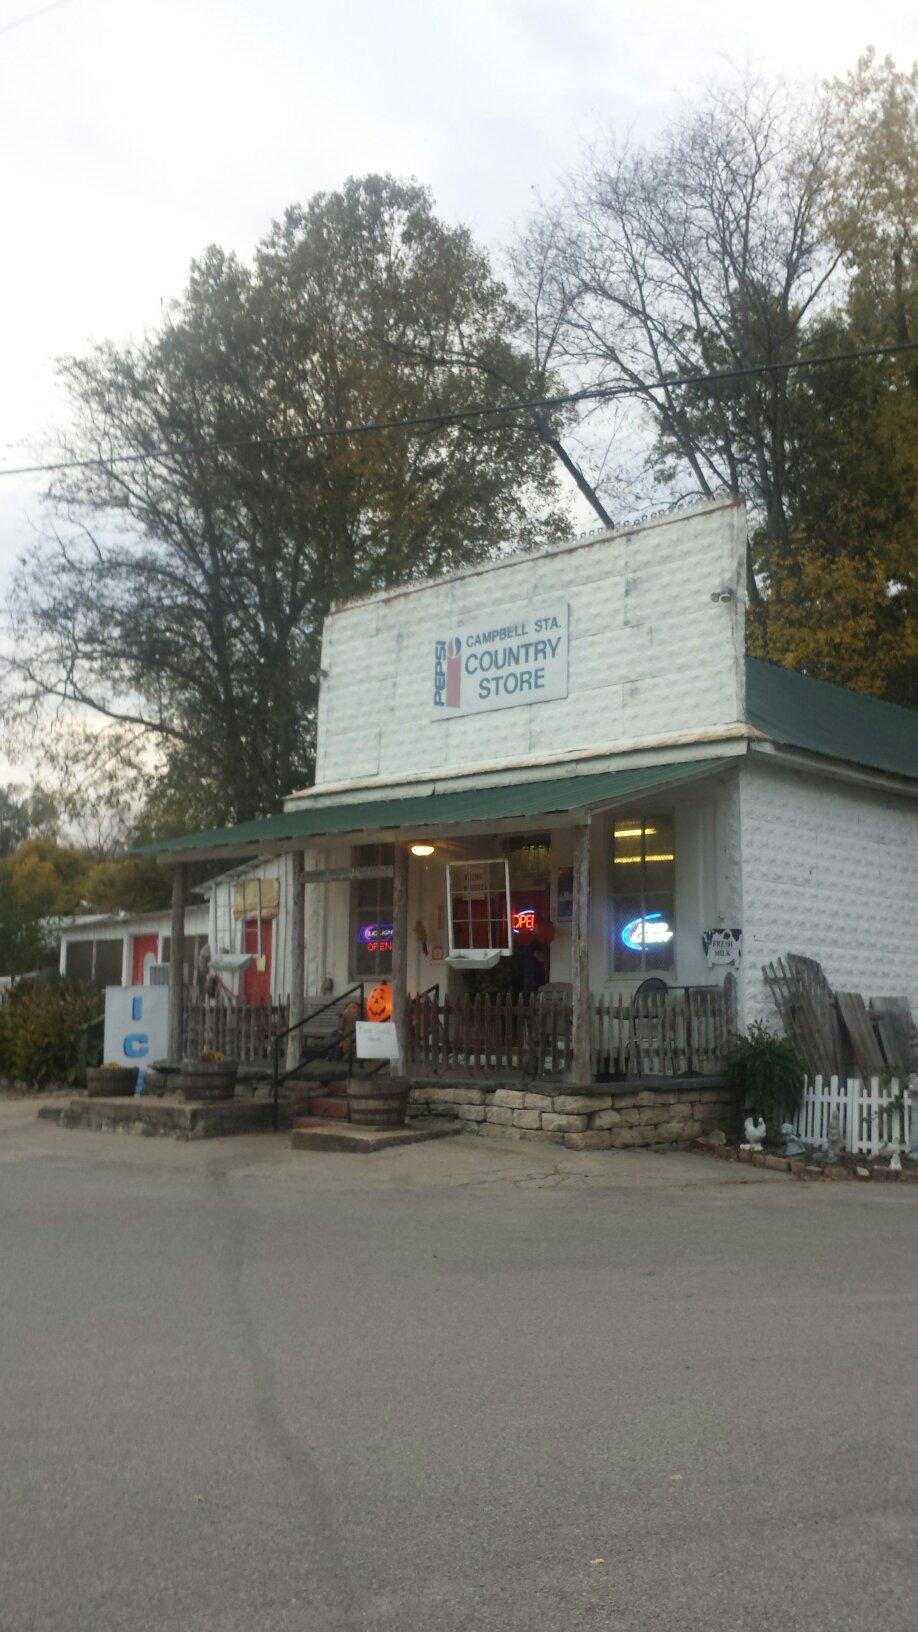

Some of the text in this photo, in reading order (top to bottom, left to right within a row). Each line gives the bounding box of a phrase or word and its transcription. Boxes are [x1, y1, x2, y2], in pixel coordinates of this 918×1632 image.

[465, 616, 562, 648] CAMPBELL STA.
[433, 640, 447, 707] PEPSI
[464, 636, 562, 676] COUNTRY
[478, 667, 545, 699] STORE
